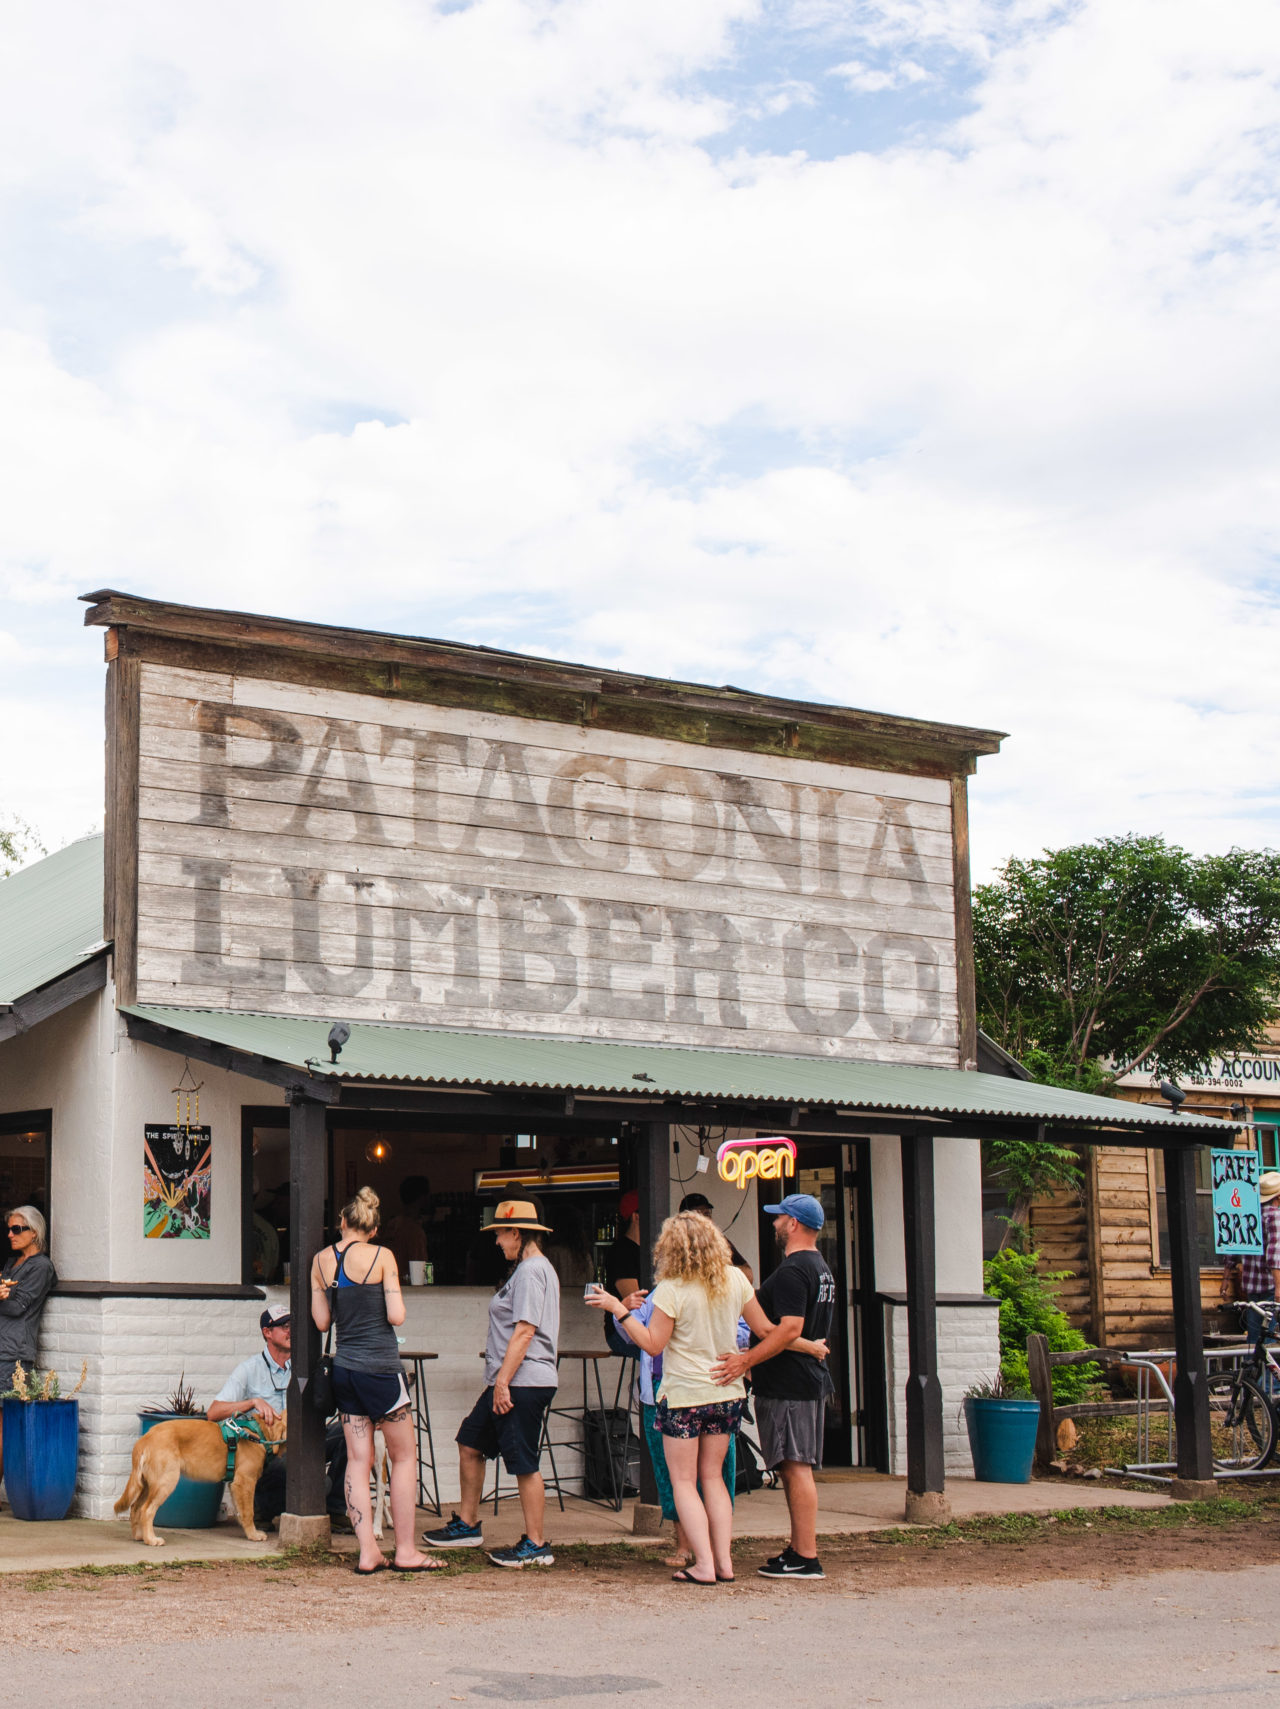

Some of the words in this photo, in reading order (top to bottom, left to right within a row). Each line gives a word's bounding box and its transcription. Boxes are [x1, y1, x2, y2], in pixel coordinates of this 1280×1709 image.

[187, 700, 939, 910] PATAGONIA
[179, 857, 745, 1026] LUMBER
[162, 1132, 184, 1140] SPIRT
[718, 1148, 794, 1189] open
[1212, 1153, 1258, 1190] CAFE
[1230, 1188, 1242, 1208] &
[1216, 1212, 1261, 1247] BAR
